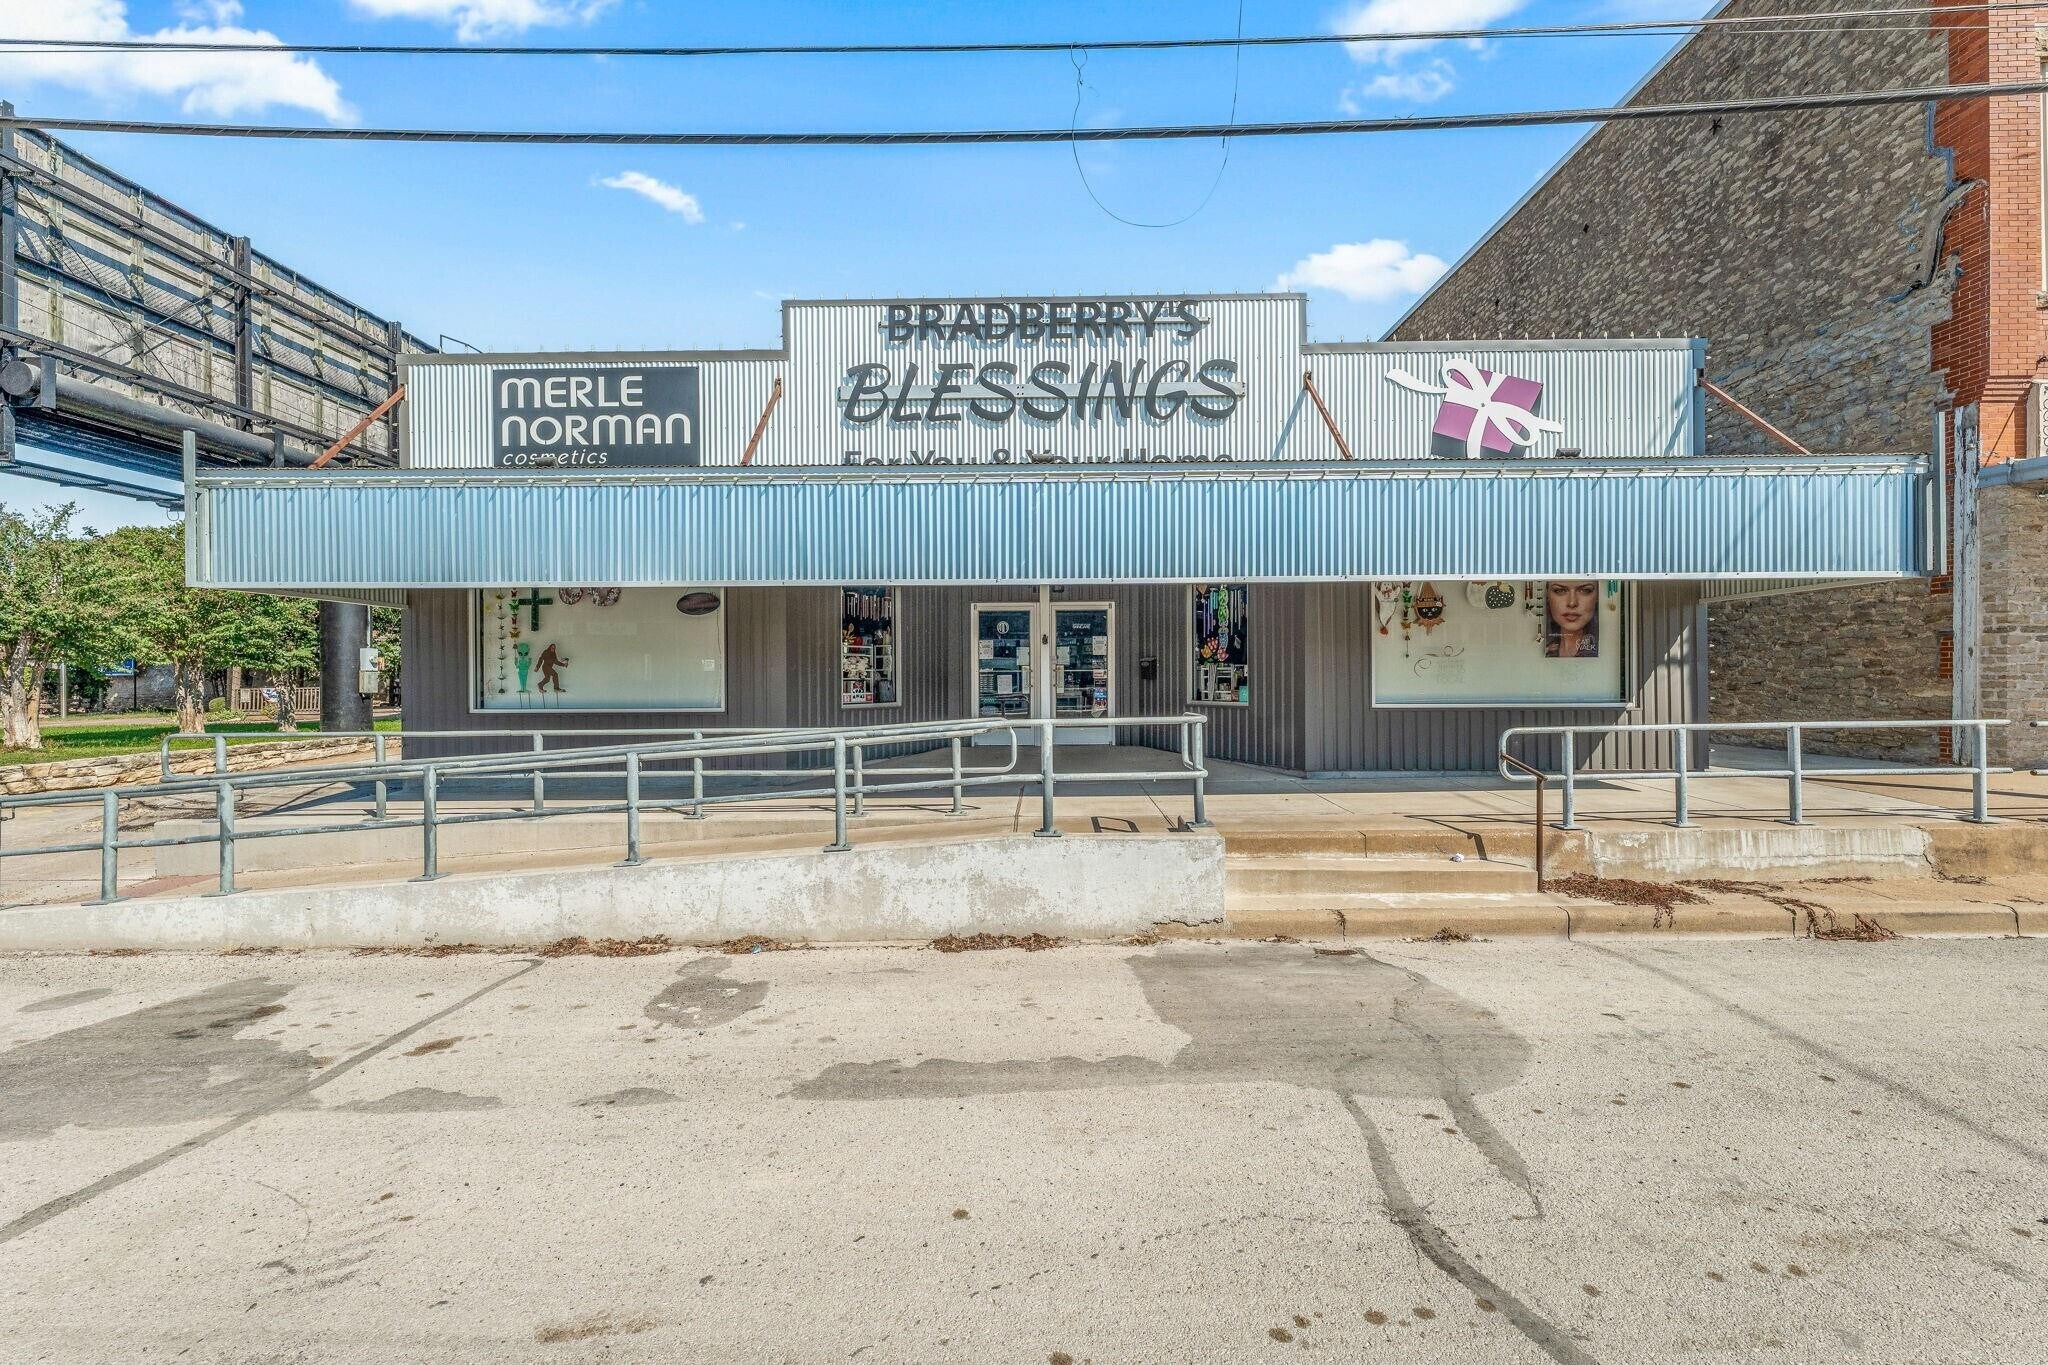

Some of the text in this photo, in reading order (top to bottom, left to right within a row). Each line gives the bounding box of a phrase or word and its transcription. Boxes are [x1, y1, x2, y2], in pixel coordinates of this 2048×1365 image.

[888, 301, 1200, 342] BRADBERRY'S
[501, 375, 643, 409] MERLE
[843, 357, 1239, 423] BLESSINGS
[501, 413, 692, 447] NORMAN
